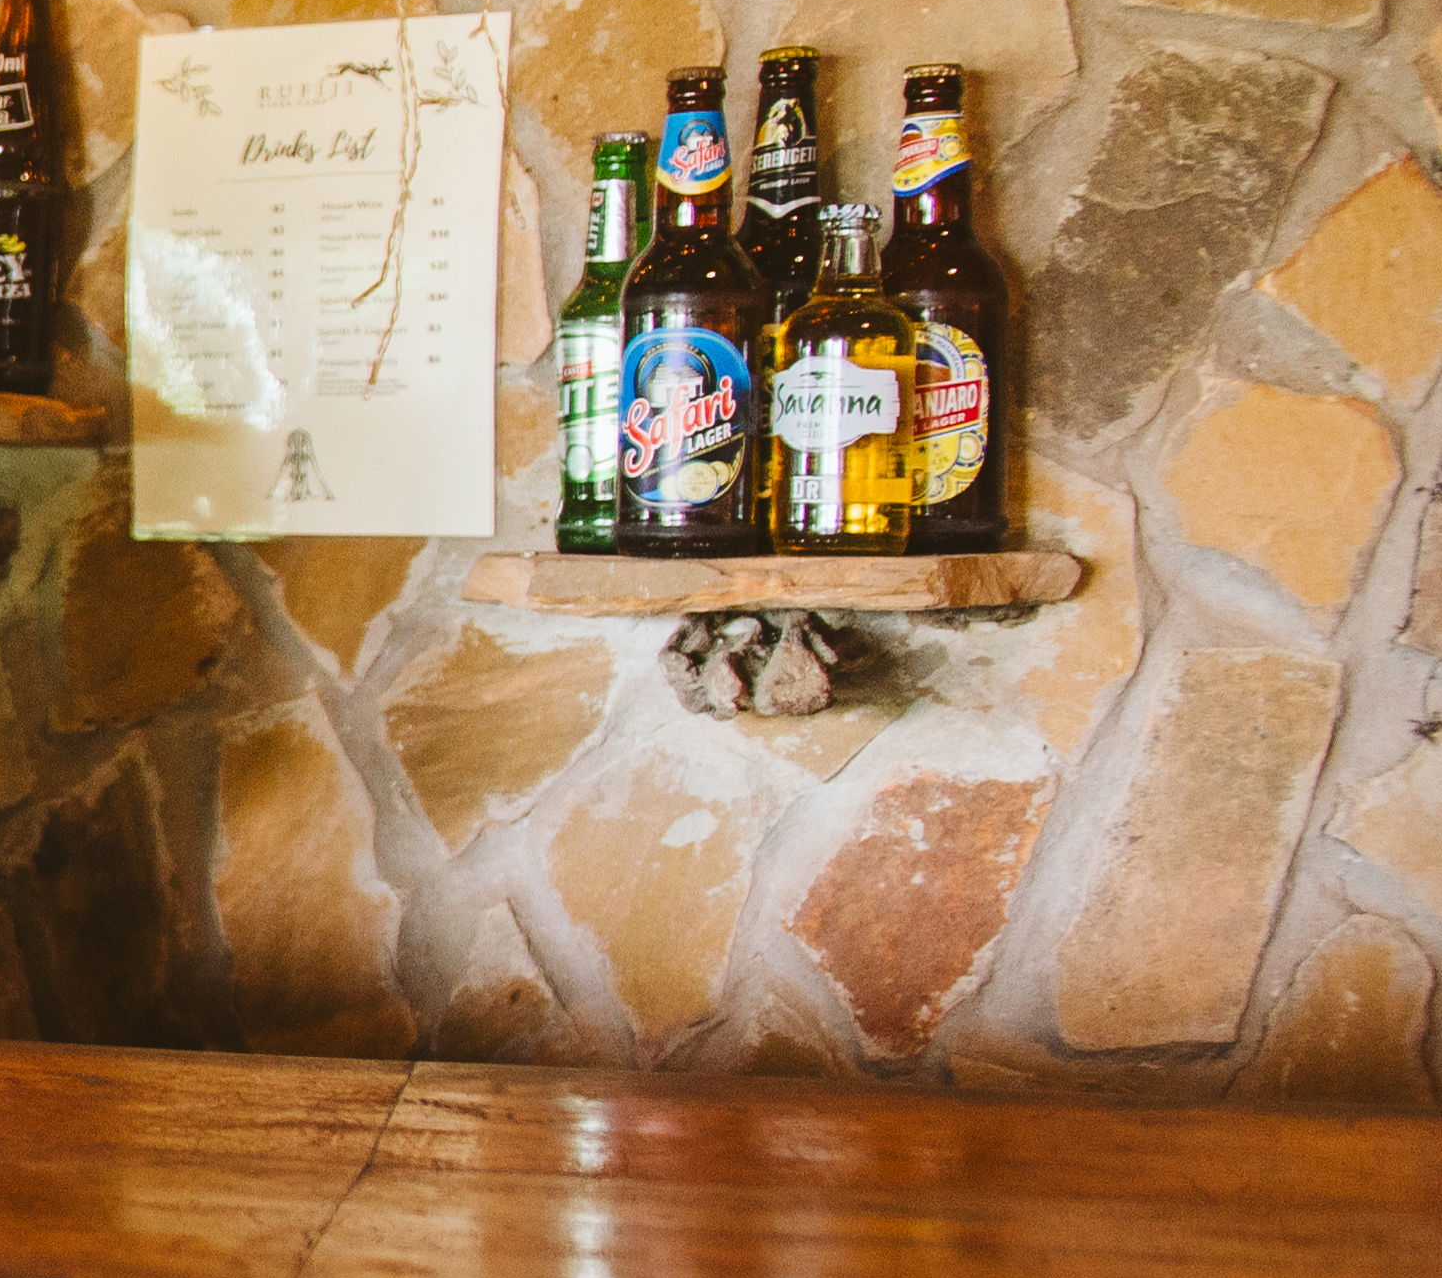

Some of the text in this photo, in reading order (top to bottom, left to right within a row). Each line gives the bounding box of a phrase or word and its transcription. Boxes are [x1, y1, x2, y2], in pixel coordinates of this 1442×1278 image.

[259, 79, 354, 100] RUFIJI
[240, 127, 378, 165] Drinks List
[669, 137, 727, 183] Safari
[776, 383, 884, 425] Savanna
[913, 383, 978, 420] ANJARO
[622, 375, 736, 478] Safari
[686, 422, 733, 454] LAGER
[793, 480, 821, 500] DR
